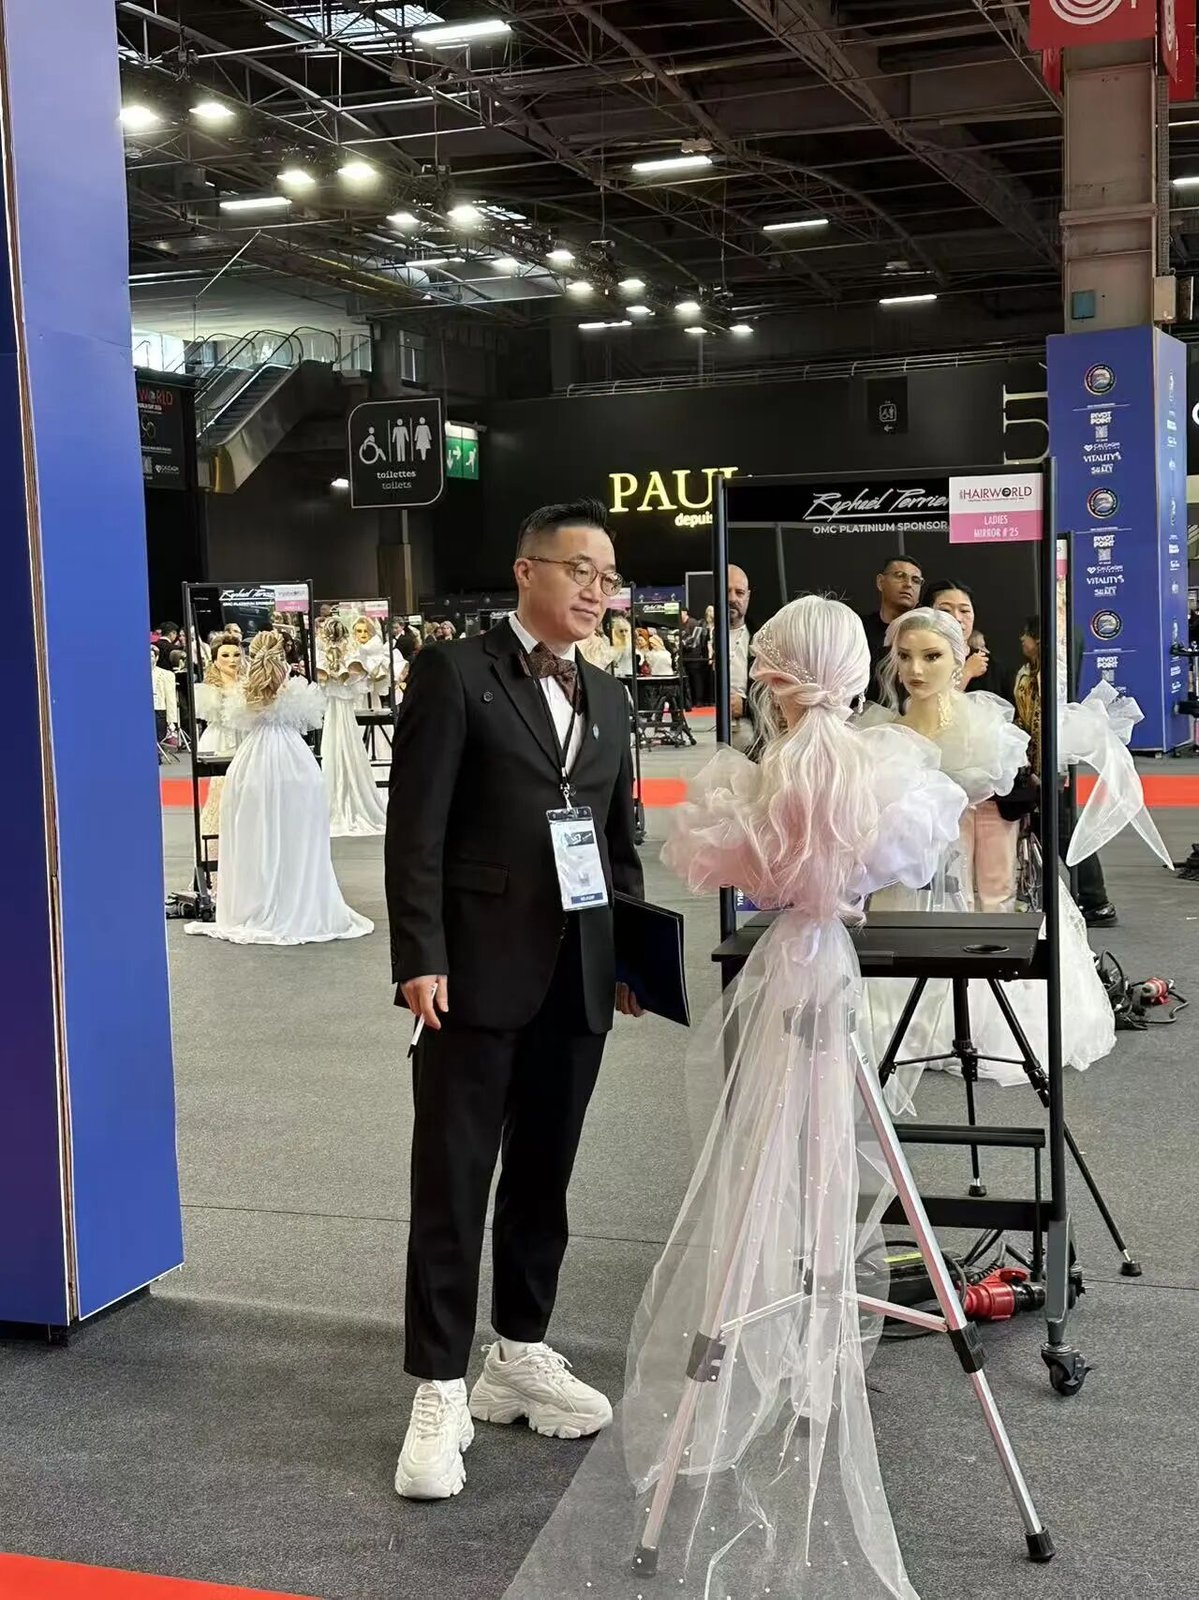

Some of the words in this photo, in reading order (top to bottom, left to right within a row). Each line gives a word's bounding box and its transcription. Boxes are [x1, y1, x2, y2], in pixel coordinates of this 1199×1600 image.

[376, 470, 417, 479] toilettes
[382, 481, 412, 490] toilets
[609, 466, 738, 513] PAU
[963, 486, 1032, 499] HAIRWORLD
[984, 514, 1008, 526] LADIES
[812, 525, 837, 534] OMC
[839, 523, 895, 533] PLATINIUM
[897, 520, 948, 531] SPONSOR
[973, 528, 1001, 538] MIRROR
[1009, 527, 1019, 537] 25
